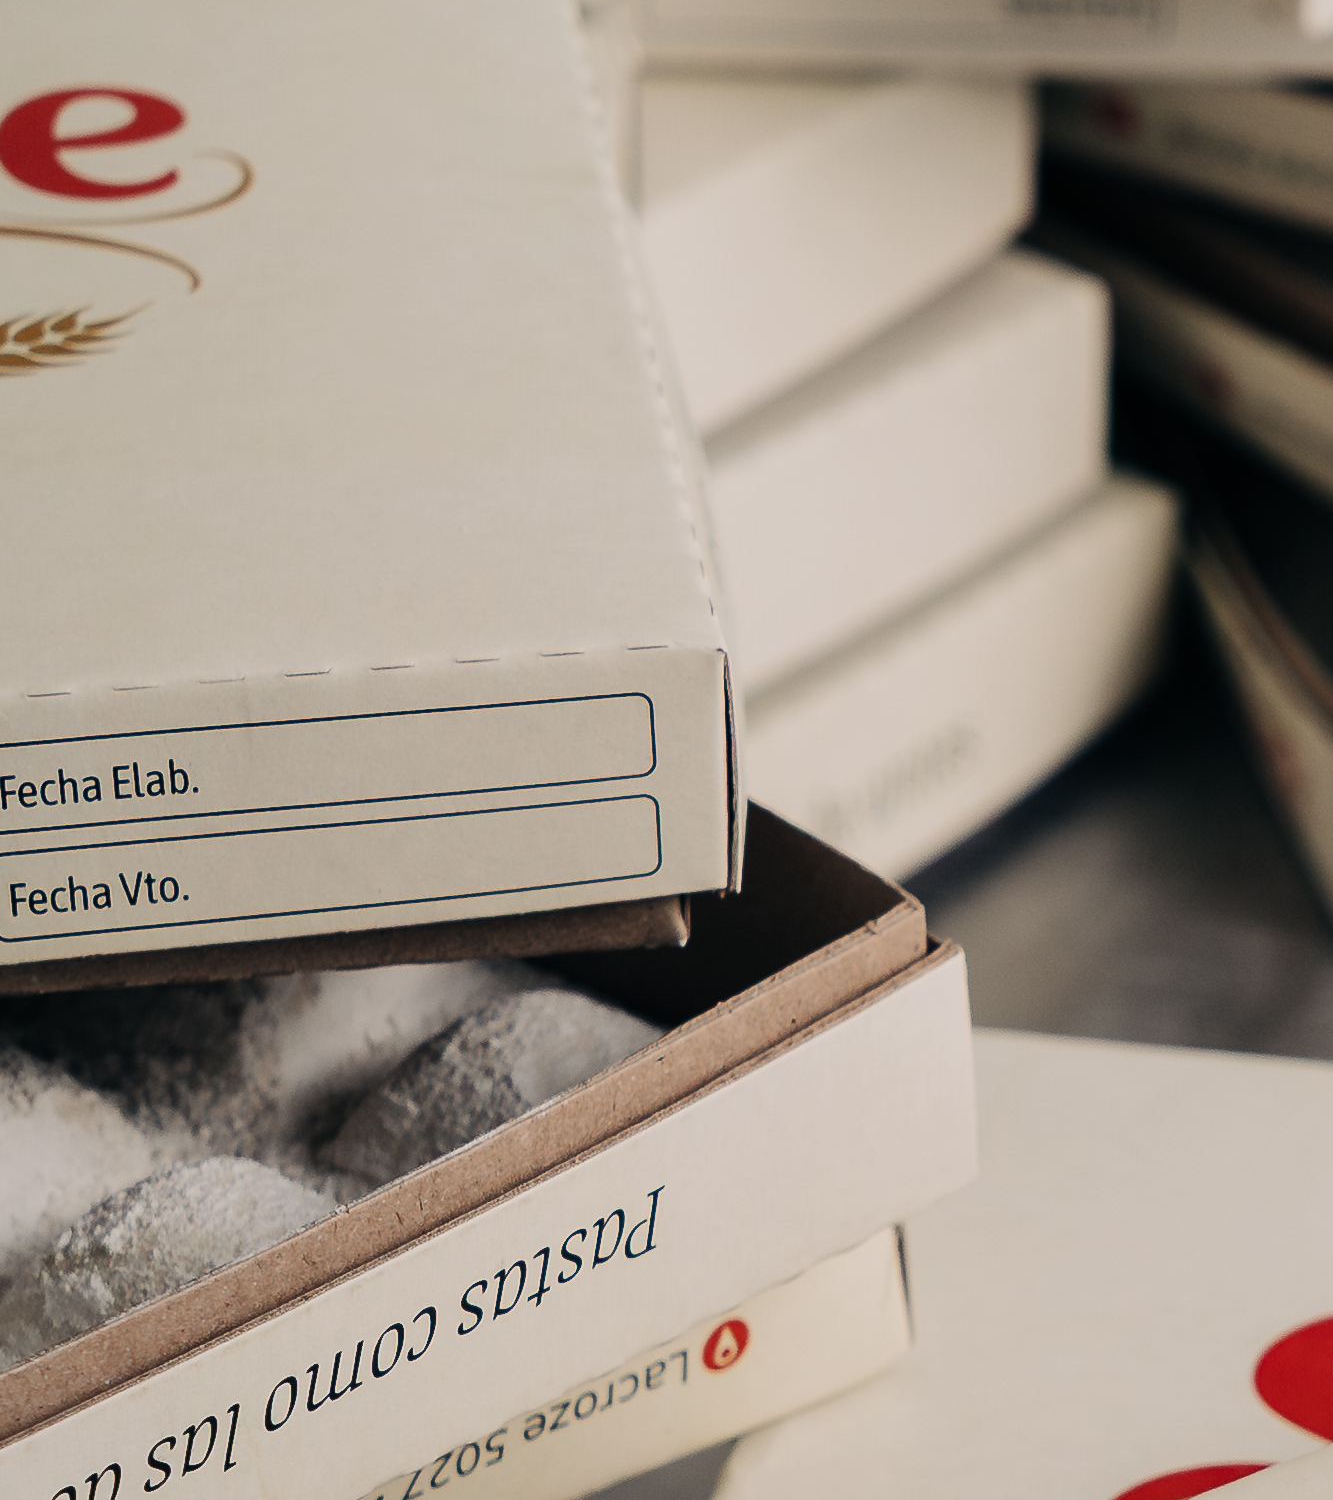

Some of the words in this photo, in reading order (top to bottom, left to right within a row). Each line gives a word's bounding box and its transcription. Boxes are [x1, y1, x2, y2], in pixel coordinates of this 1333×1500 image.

[0, 768, 101, 810] Fecha
[112, 758, 199, 800] Elab.
[9, 876, 111, 917] Fecha
[119, 871, 189, 906] Vto.
[457, 1185, 666, 1336] Pastas
[264, 1305, 438, 1434] como
[522, 1350, 689, 1442] Lacroze
[143, 1402, 241, 1495] las
